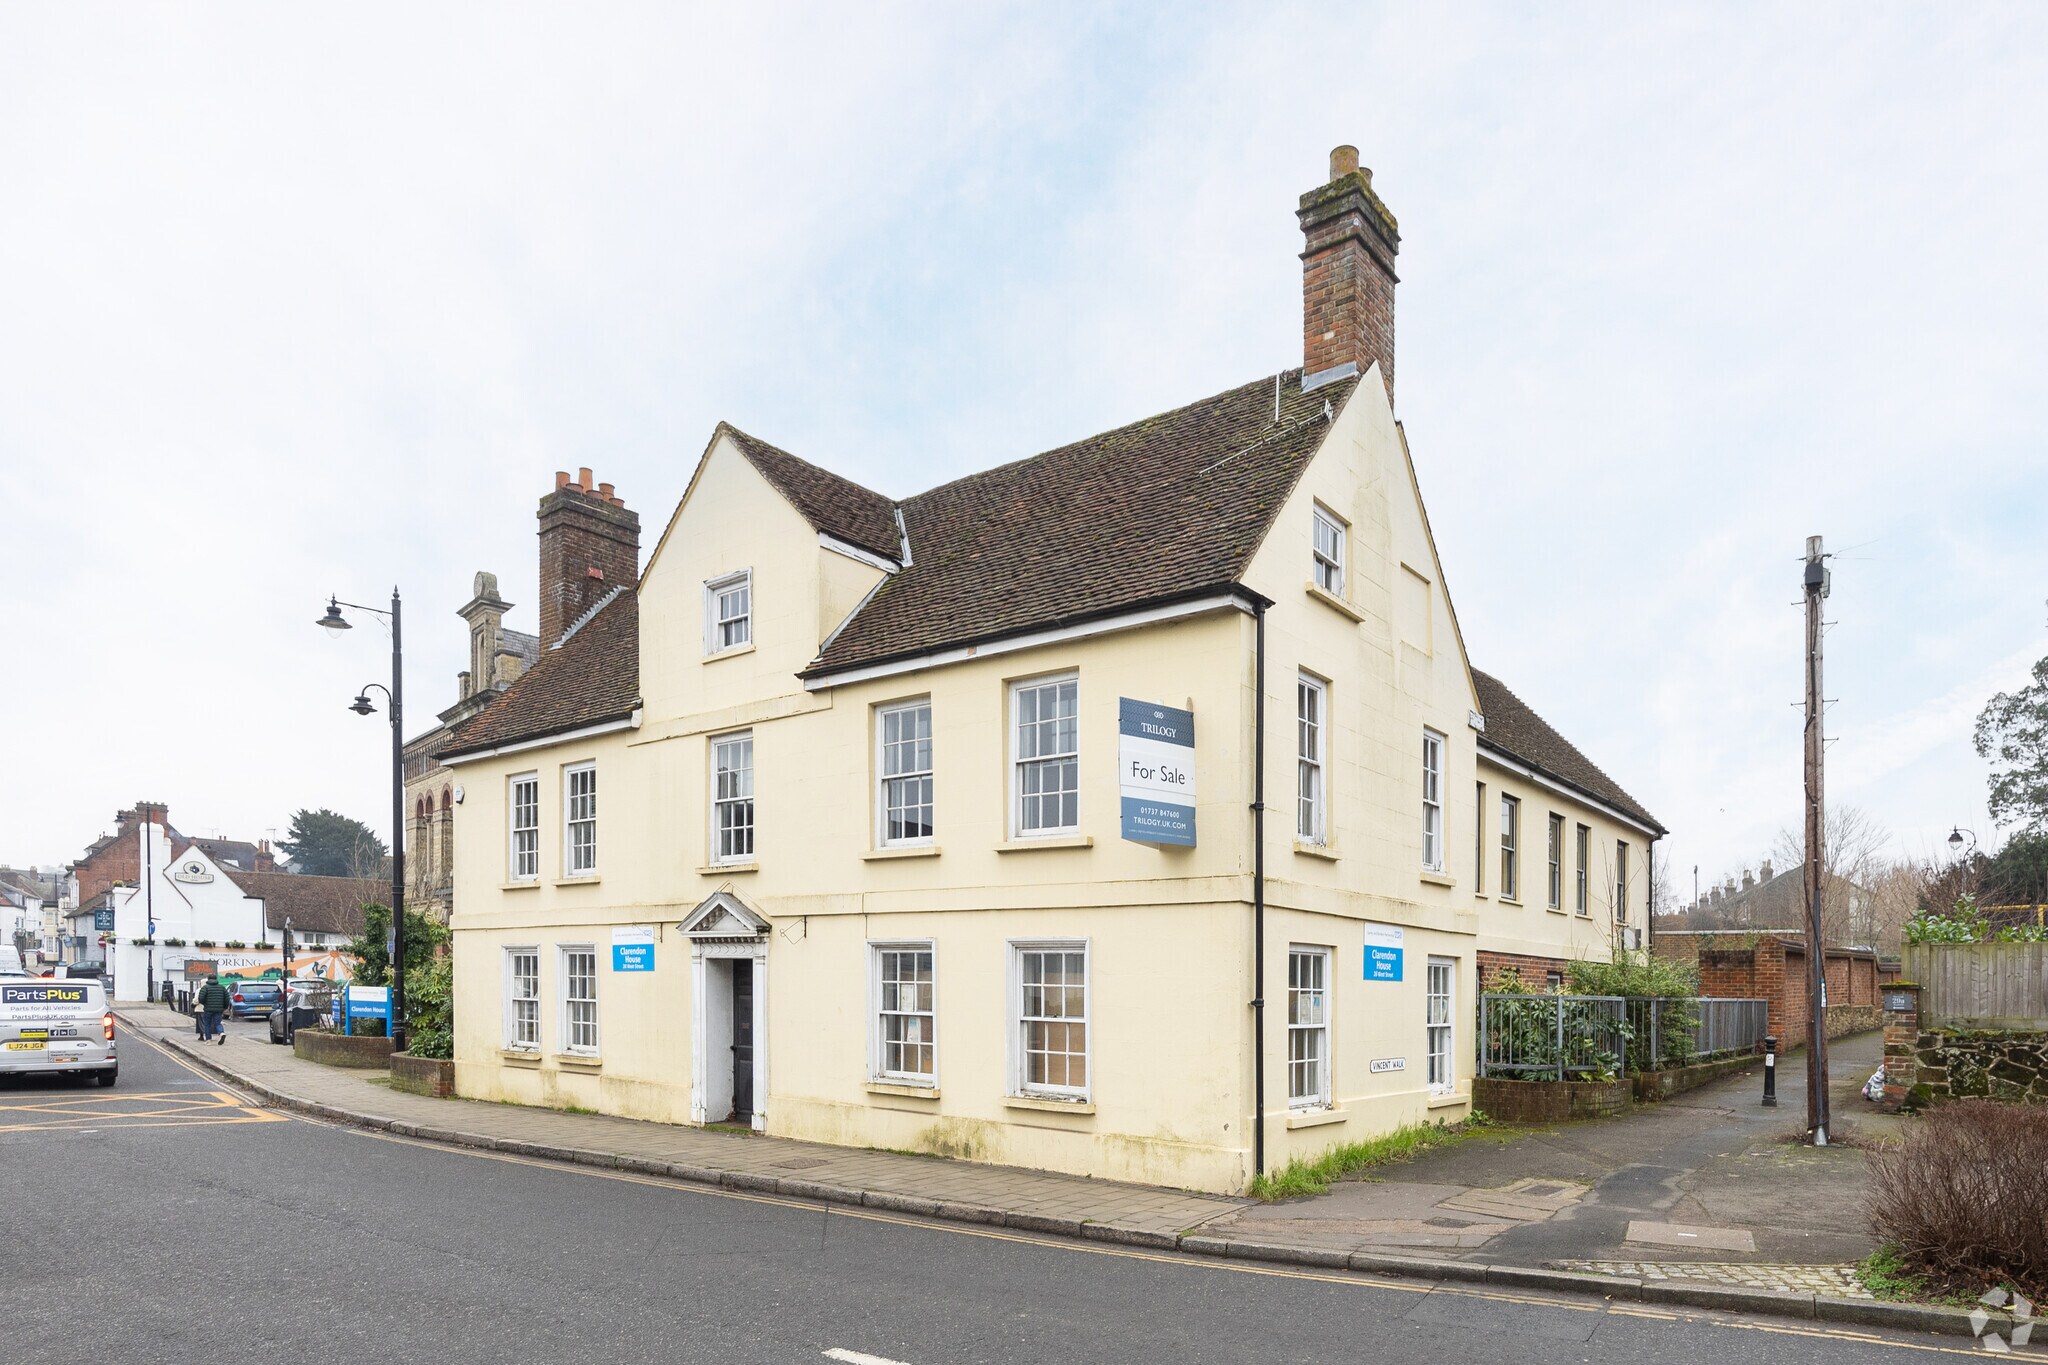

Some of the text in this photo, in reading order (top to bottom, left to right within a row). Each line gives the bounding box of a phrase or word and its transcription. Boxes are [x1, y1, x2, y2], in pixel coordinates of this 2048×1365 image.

[1141, 722, 1177, 738] TRILOGY
[1132, 761, 1186, 785] For Sale
[1140, 807, 1180, 819] 01737 847600
[620, 947, 646, 955] Clarendon
[1372, 949, 1396, 960] Clarendon
[625, 955, 641, 963] House
[1376, 961, 1391, 970] House
[7, 989, 81, 1001] PartsPlus
[1372, 1060, 1404, 1070] VINCENT WALK
